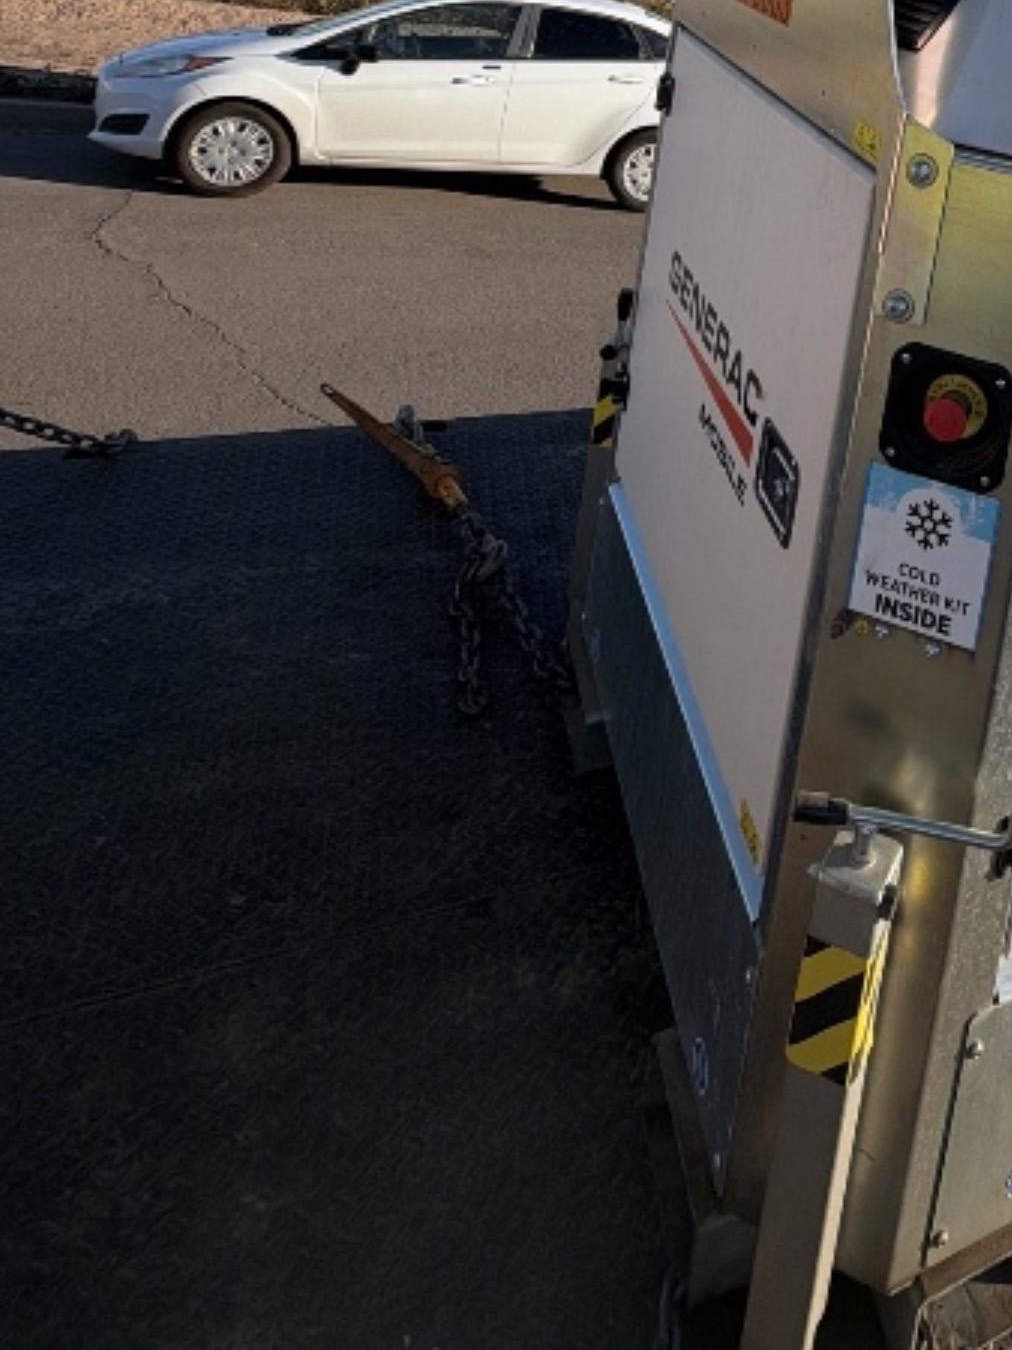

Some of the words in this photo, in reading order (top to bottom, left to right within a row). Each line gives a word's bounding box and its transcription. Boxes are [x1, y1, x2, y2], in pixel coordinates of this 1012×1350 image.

[668, 250, 763, 427] GENERAC
[865, 569, 940, 607] WEATHER
[944, 596, 971, 616] KIT
[898, 562, 940, 586] COLD
[874, 592, 952, 637] INSIDE
